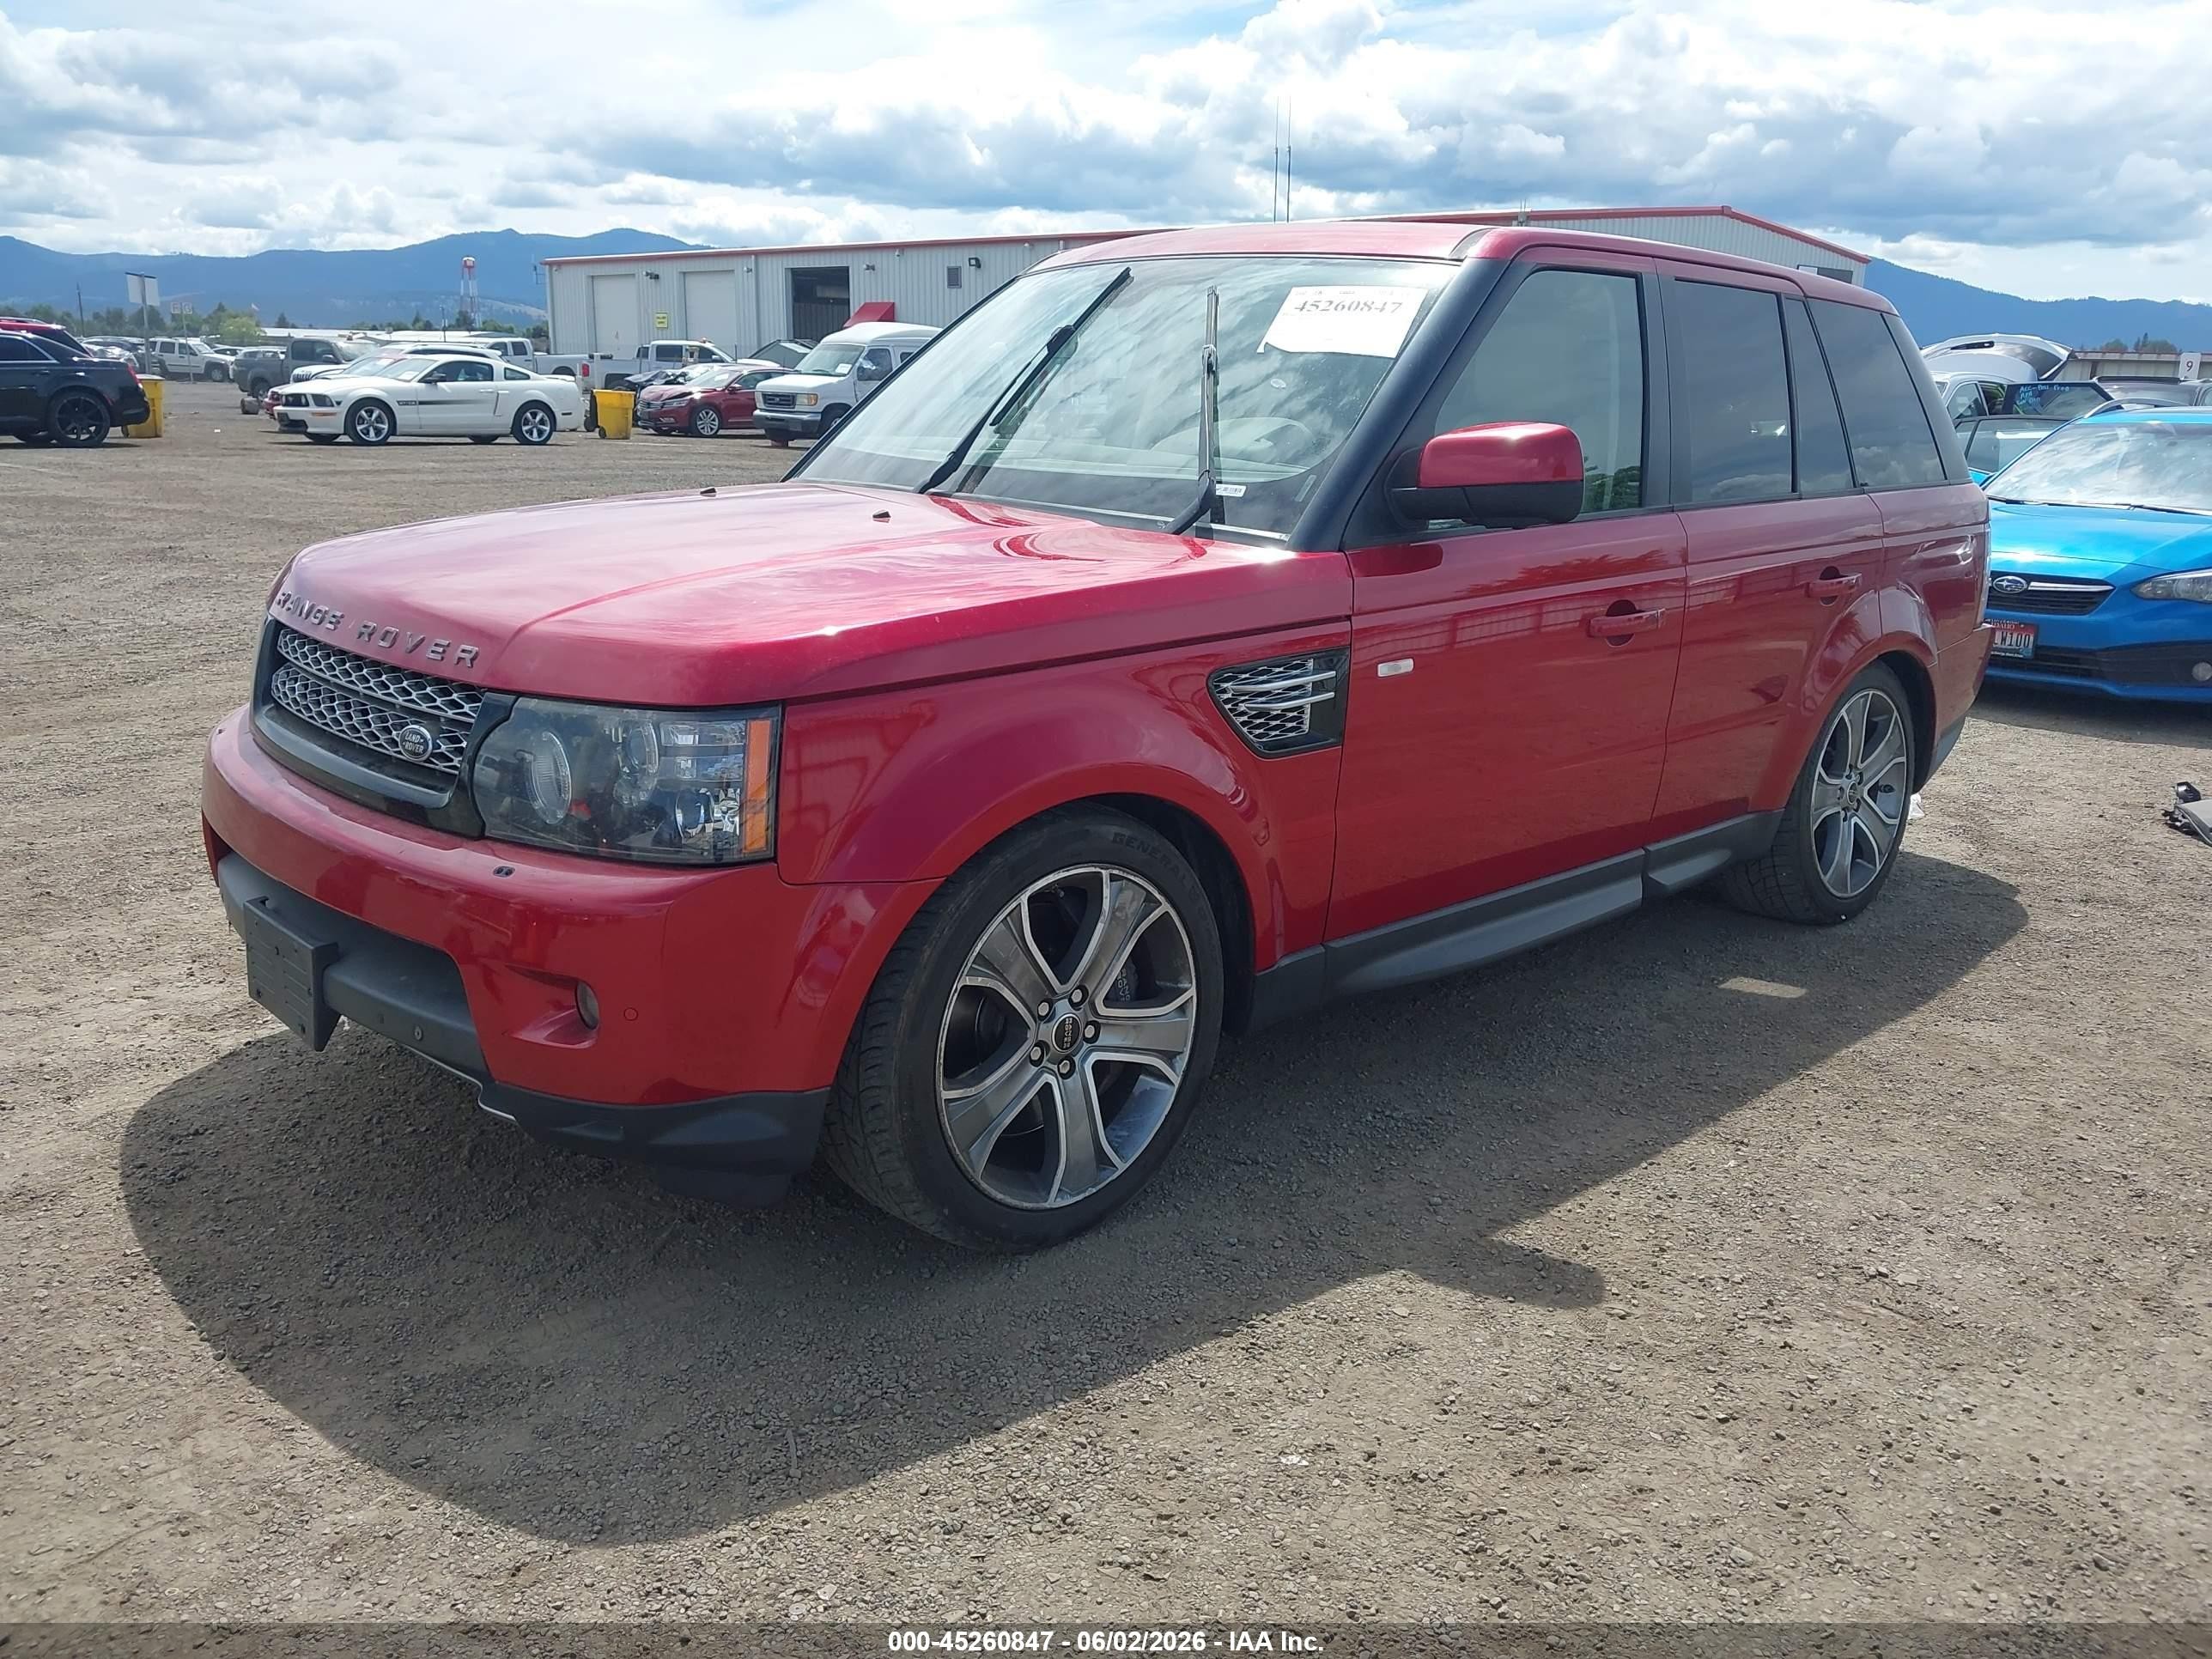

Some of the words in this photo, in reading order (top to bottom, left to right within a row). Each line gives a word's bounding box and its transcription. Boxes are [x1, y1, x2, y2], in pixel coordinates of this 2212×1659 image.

[1293, 300, 1403, 313] 45260847
[2185, 360, 2194, 372] 9
[277, 590, 345, 631] RANGE
[356, 620, 479, 669] ROVER
[404, 730, 421, 743] LAND
[404, 741, 424, 754] ROVER
